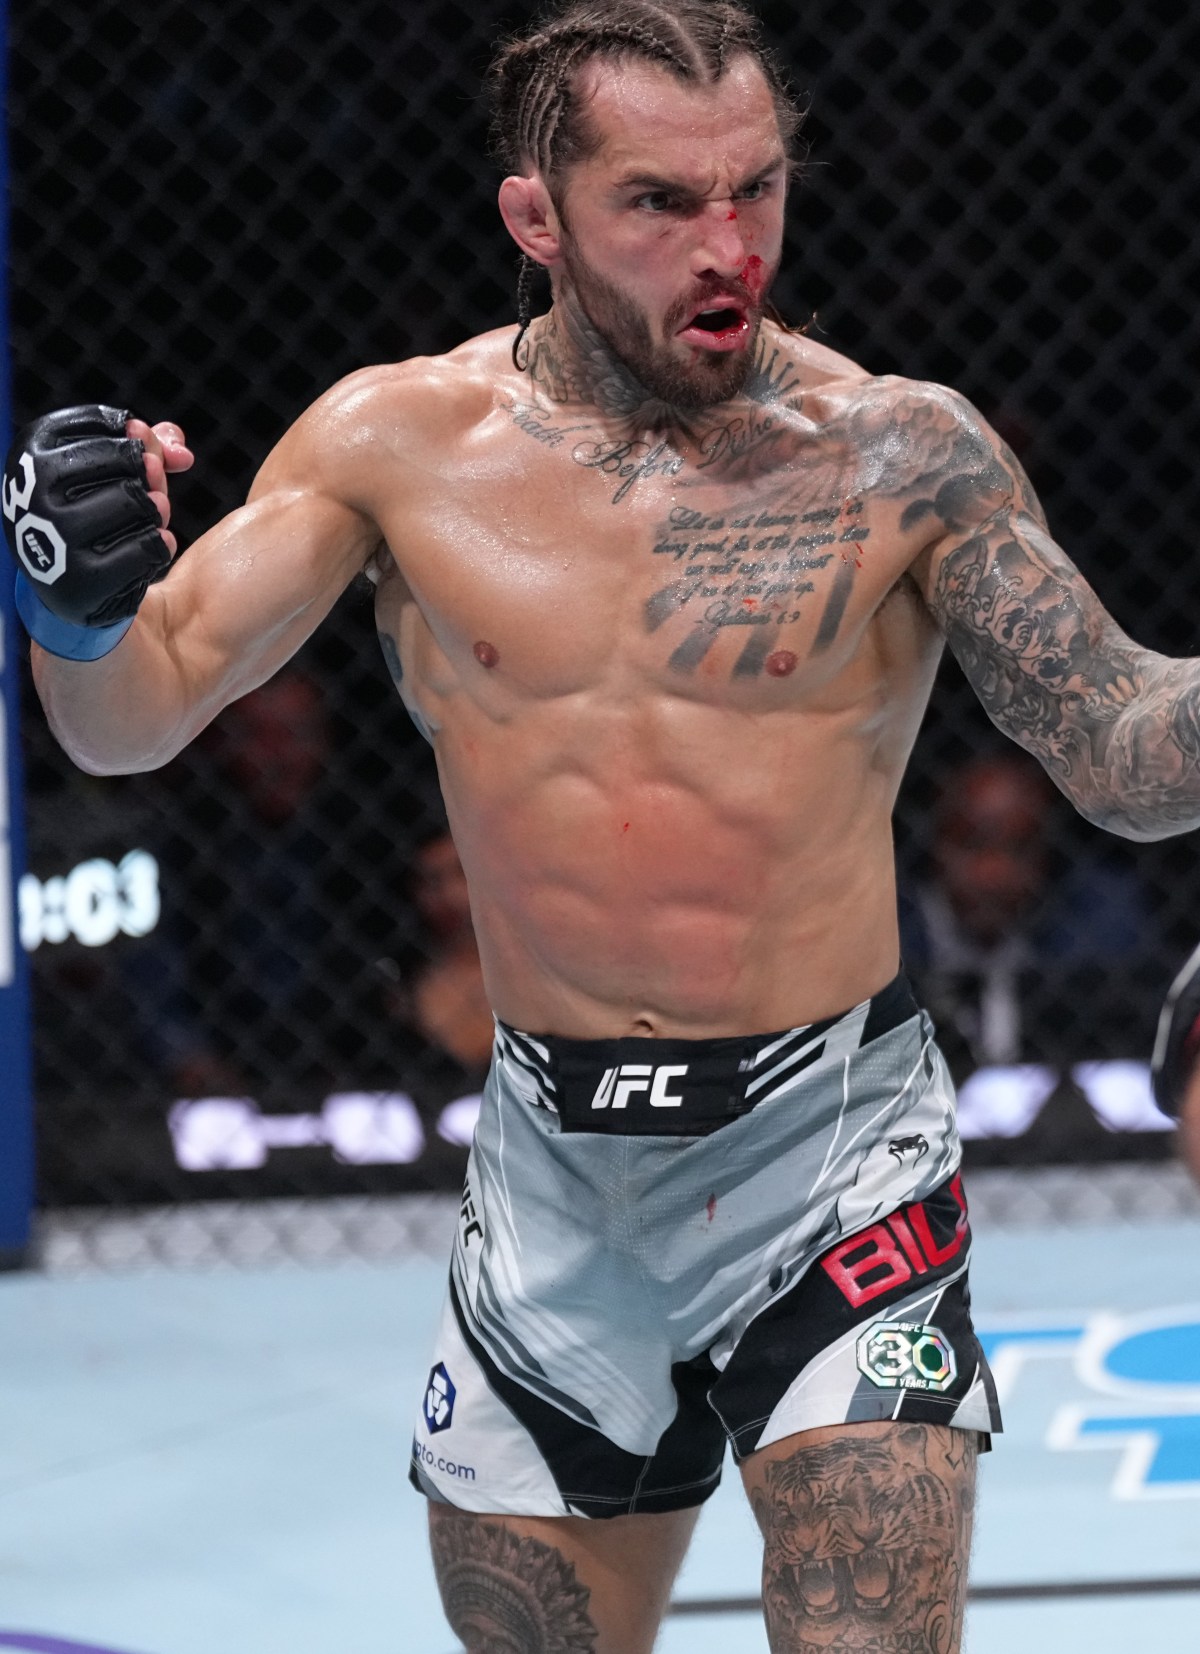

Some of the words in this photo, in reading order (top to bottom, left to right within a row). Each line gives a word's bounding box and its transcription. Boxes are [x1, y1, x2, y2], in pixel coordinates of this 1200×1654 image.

[696, 408, 775, 469] Disho
[24, 532, 51, 568] UFC
[592, 1065, 688, 1109] UFC
[874, 1332, 950, 1382] 30
[900, 1379, 927, 1389] YEARS
[415, 1441, 476, 1481] pto.com
